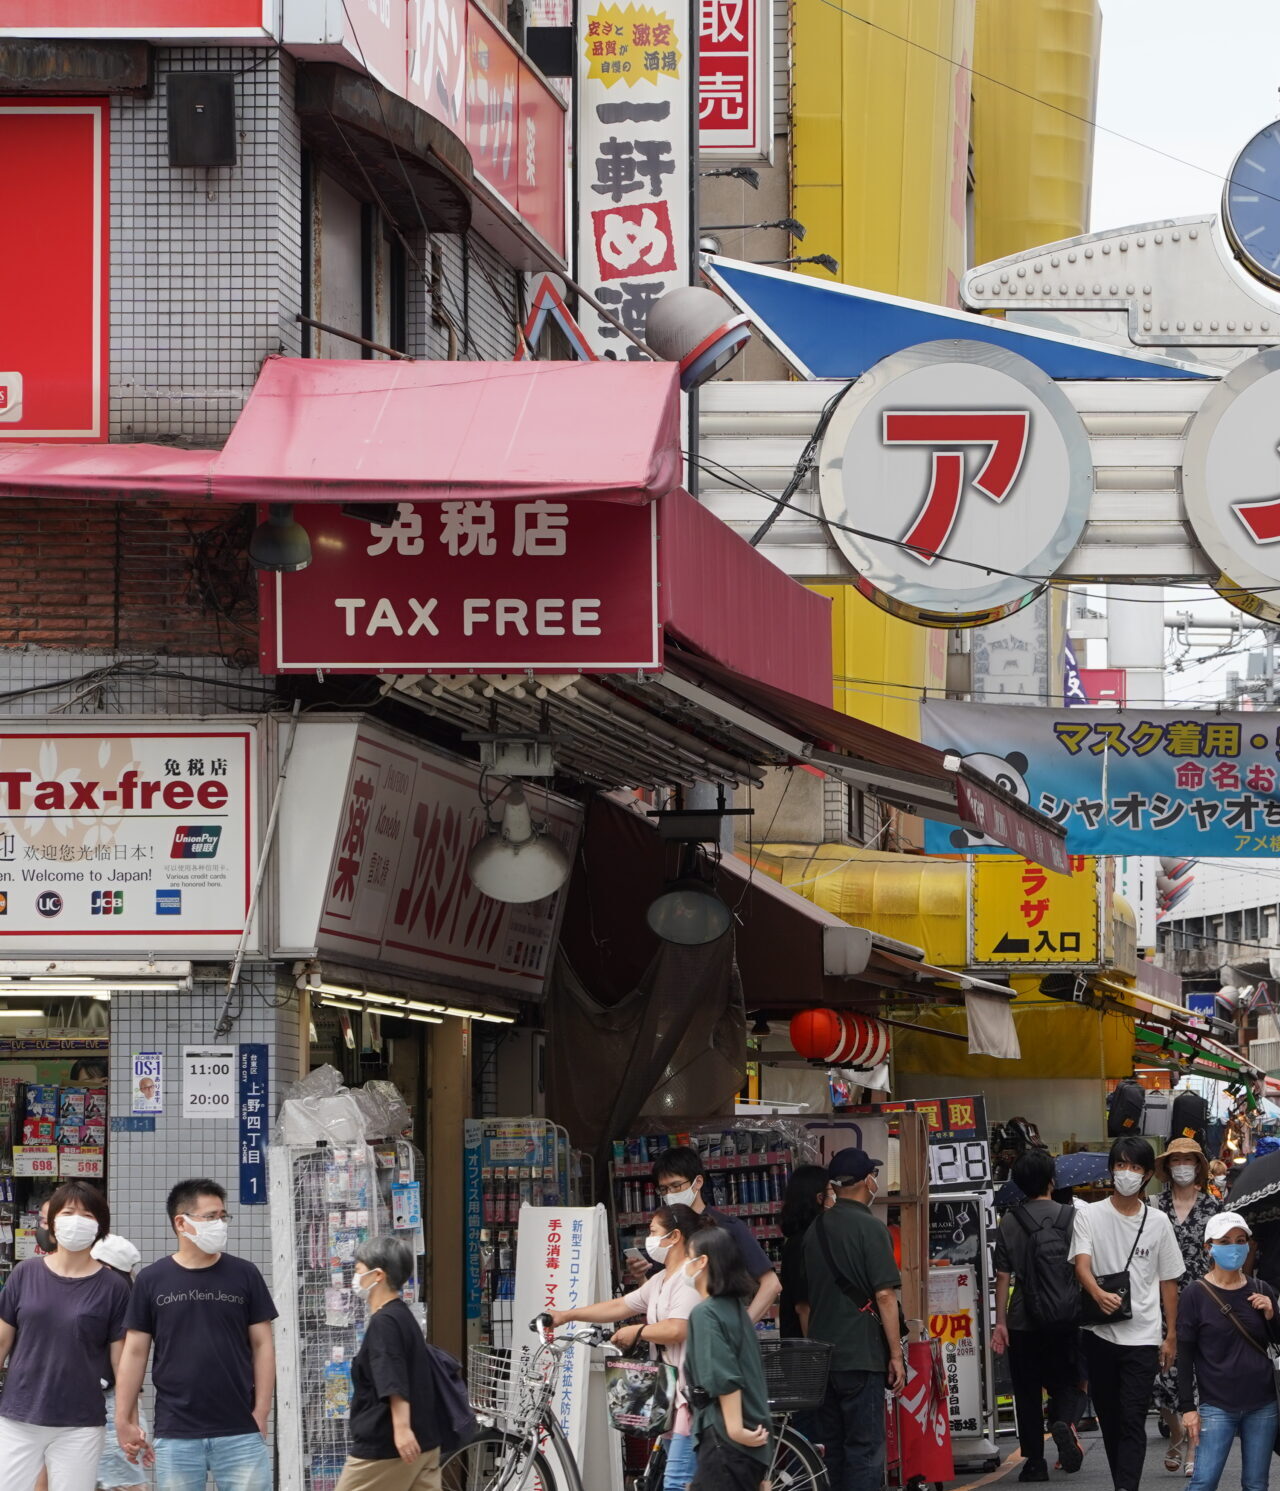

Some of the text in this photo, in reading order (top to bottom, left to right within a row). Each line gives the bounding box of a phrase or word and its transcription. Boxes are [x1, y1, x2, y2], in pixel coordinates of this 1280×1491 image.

[588, 21, 624, 37] 安さと
[632, 23, 673, 47] 激安
[592, 40, 629, 56] 品質が
[601, 60, 632, 73] 自慢の
[643, 51, 678, 71] 酒場
[366, 500, 570, 557] 免税店
[335, 597, 602, 637] TAX FREE
[164, 758, 229, 777] 免税店
[0, 770, 229, 811] Tax-free
[175, 833, 218, 845] UnionPay
[22, 869, 84, 882] Welcome
[90, 870, 103, 882] to
[107, 869, 152, 884] Japan!
[91, 898, 123, 908] JCB
[1034, 931, 1081, 953] 入口
[134, 1060, 161, 1076] OS-1
[190, 1064, 230, 1075] 11:00
[250, 1054, 258, 1074] 台東区
[190, 1094, 230, 1105] 20:00
[247, 1081, 261, 1164] 上野四丁目
[32, 1160, 53, 1171] 698
[250, 1177, 257, 1194] 1
[156, 1289, 244, 1306] Calvin Klein Jeans
